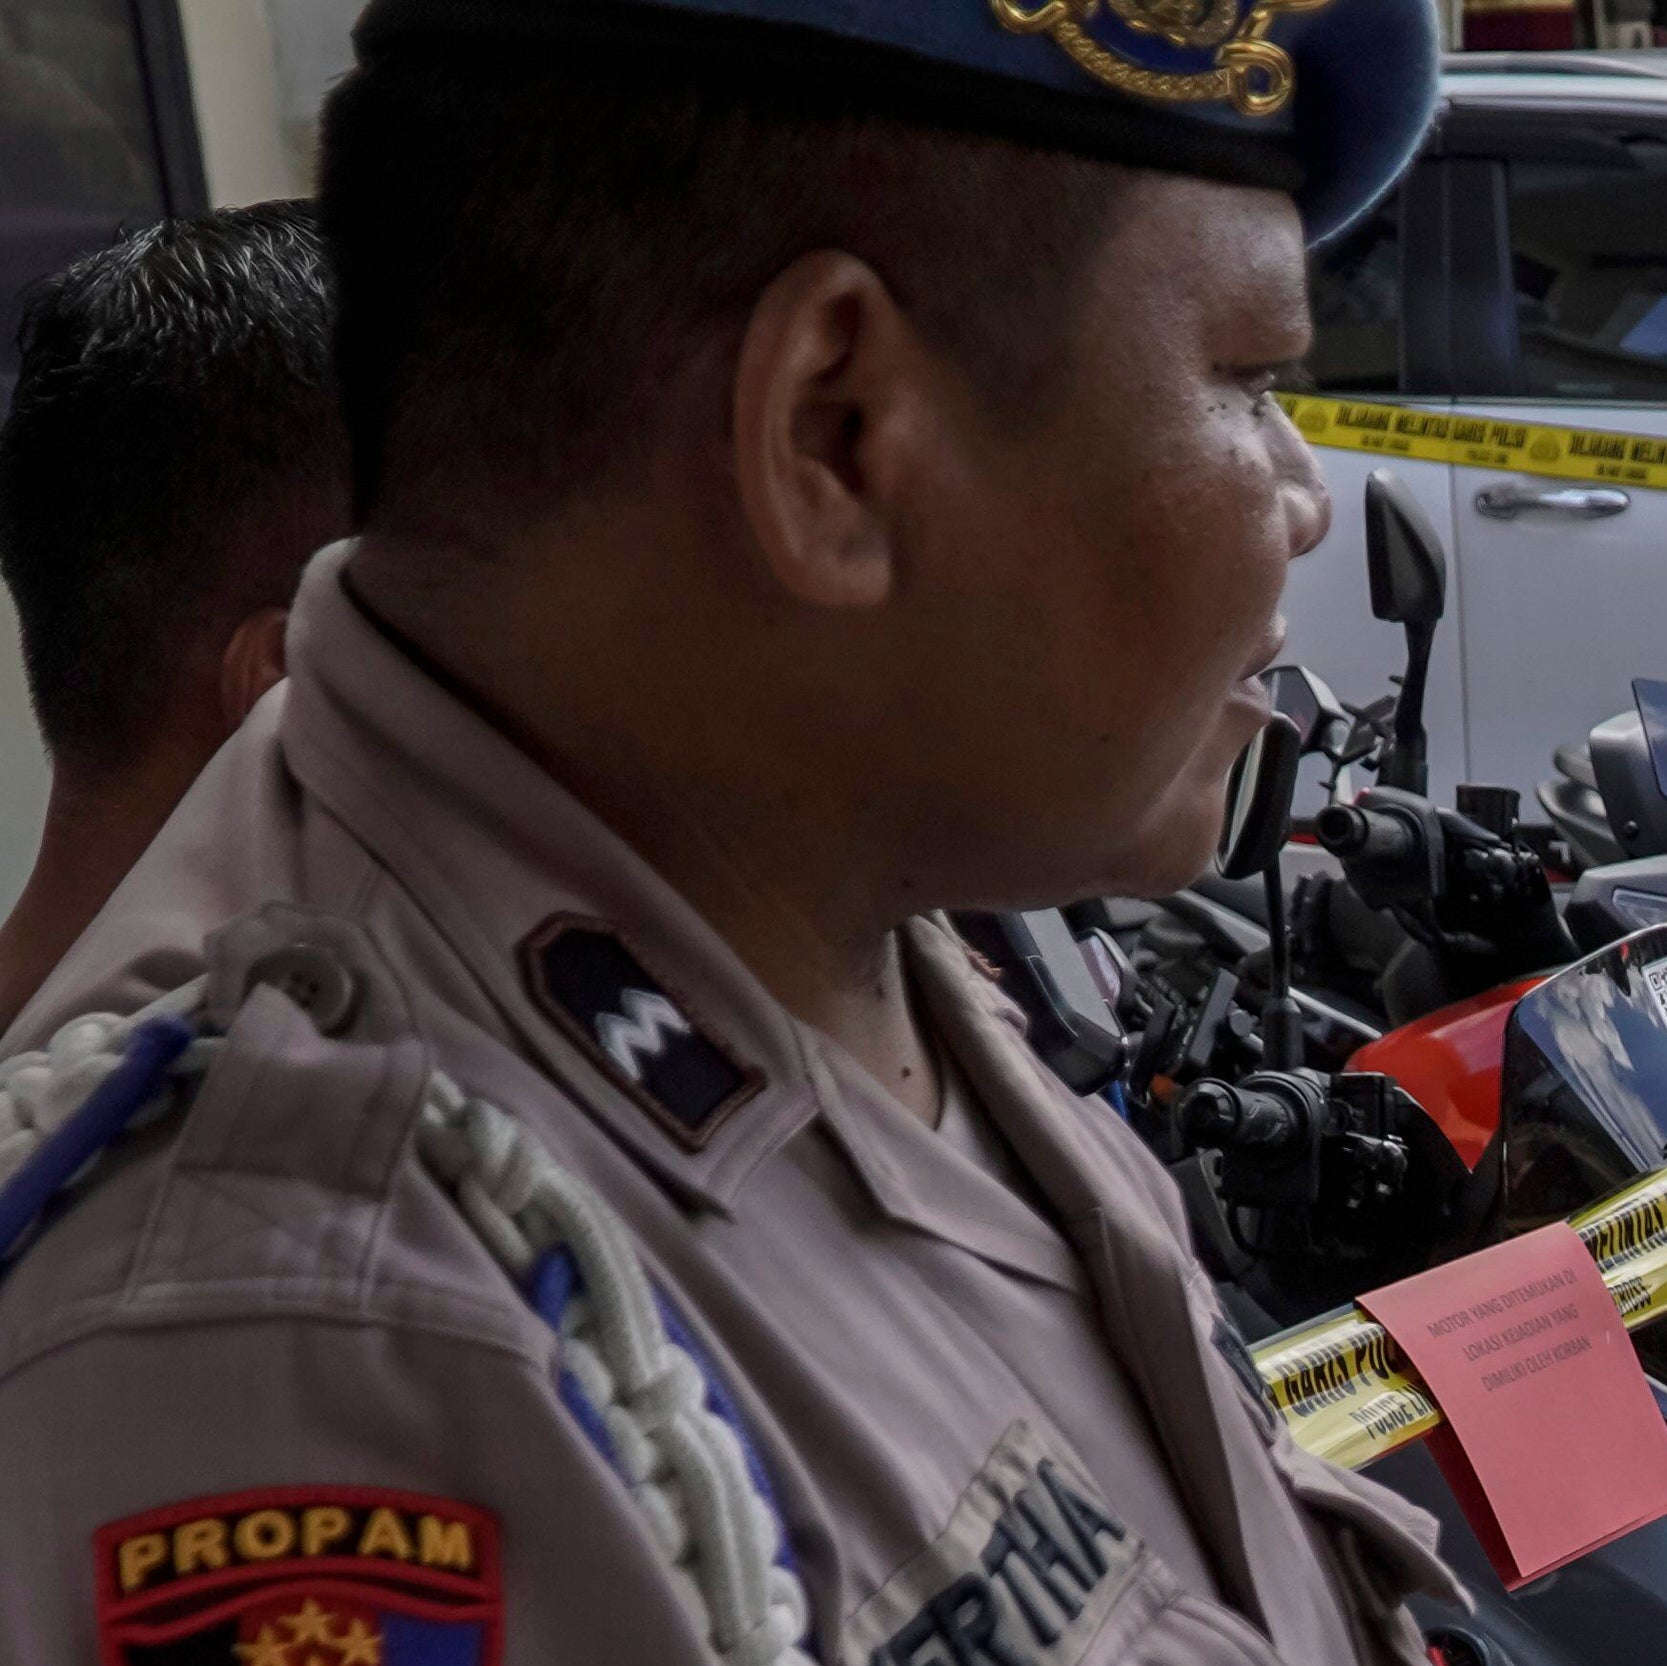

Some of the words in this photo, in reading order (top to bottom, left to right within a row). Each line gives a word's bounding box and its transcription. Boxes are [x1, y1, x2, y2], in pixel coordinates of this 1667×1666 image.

[1426, 1309, 1473, 1339] MOTOR
[1470, 1296, 1504, 1327] YANG
[1500, 1270, 1567, 1316] DITEMUKAN
[1563, 1268, 1578, 1288] DI
[1461, 1331, 1504, 1363] LOKASI
[1547, 1303, 1581, 1333] YANG
[119, 1508, 473, 1592] PROPAM
